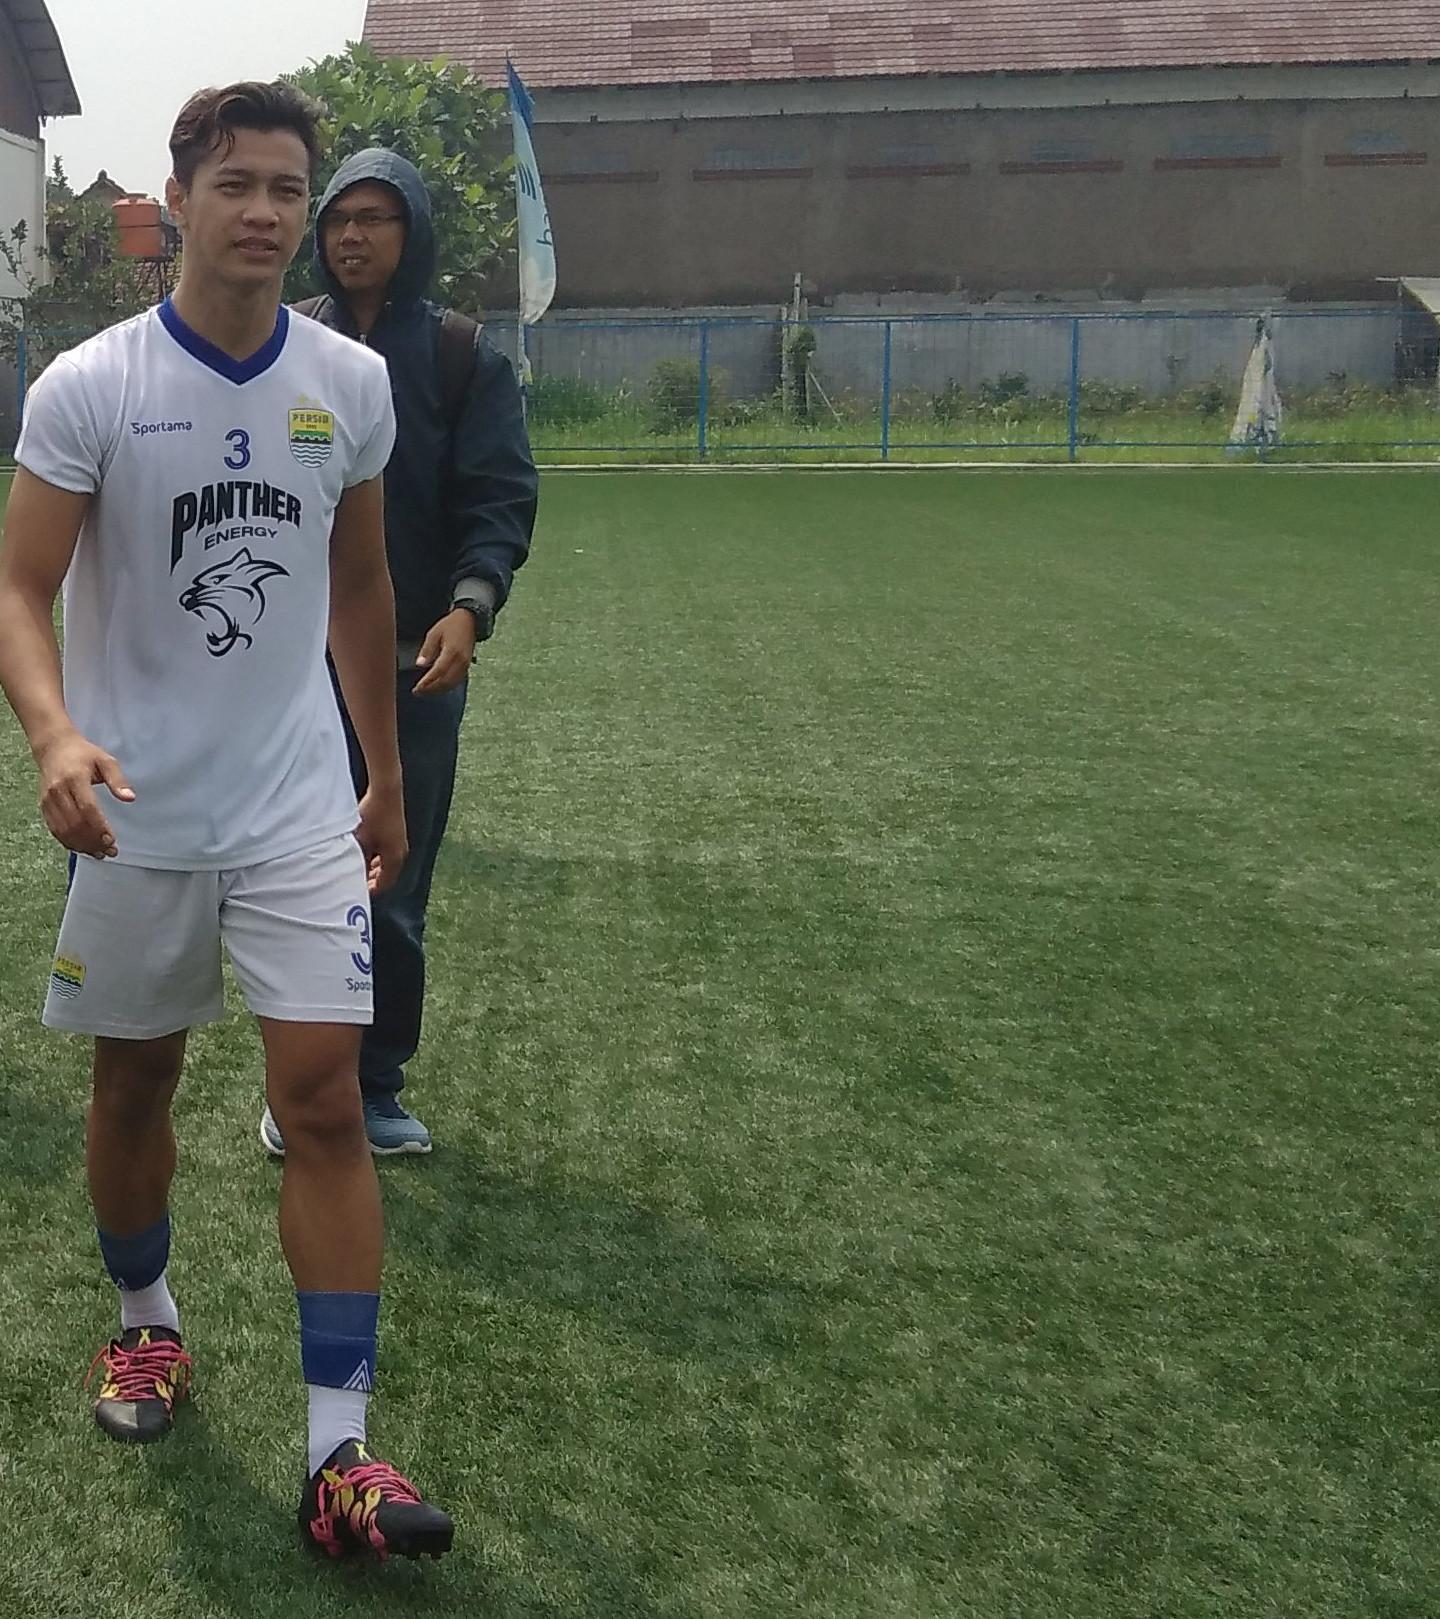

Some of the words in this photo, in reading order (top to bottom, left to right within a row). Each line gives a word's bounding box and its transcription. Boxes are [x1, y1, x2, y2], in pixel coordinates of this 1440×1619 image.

[130, 421, 192, 436] Sportama
[223, 428, 252, 470] 3
[170, 478, 302, 576] PANTHER
[204, 526, 278, 550] ENERGY
[346, 905, 372, 975] 3
